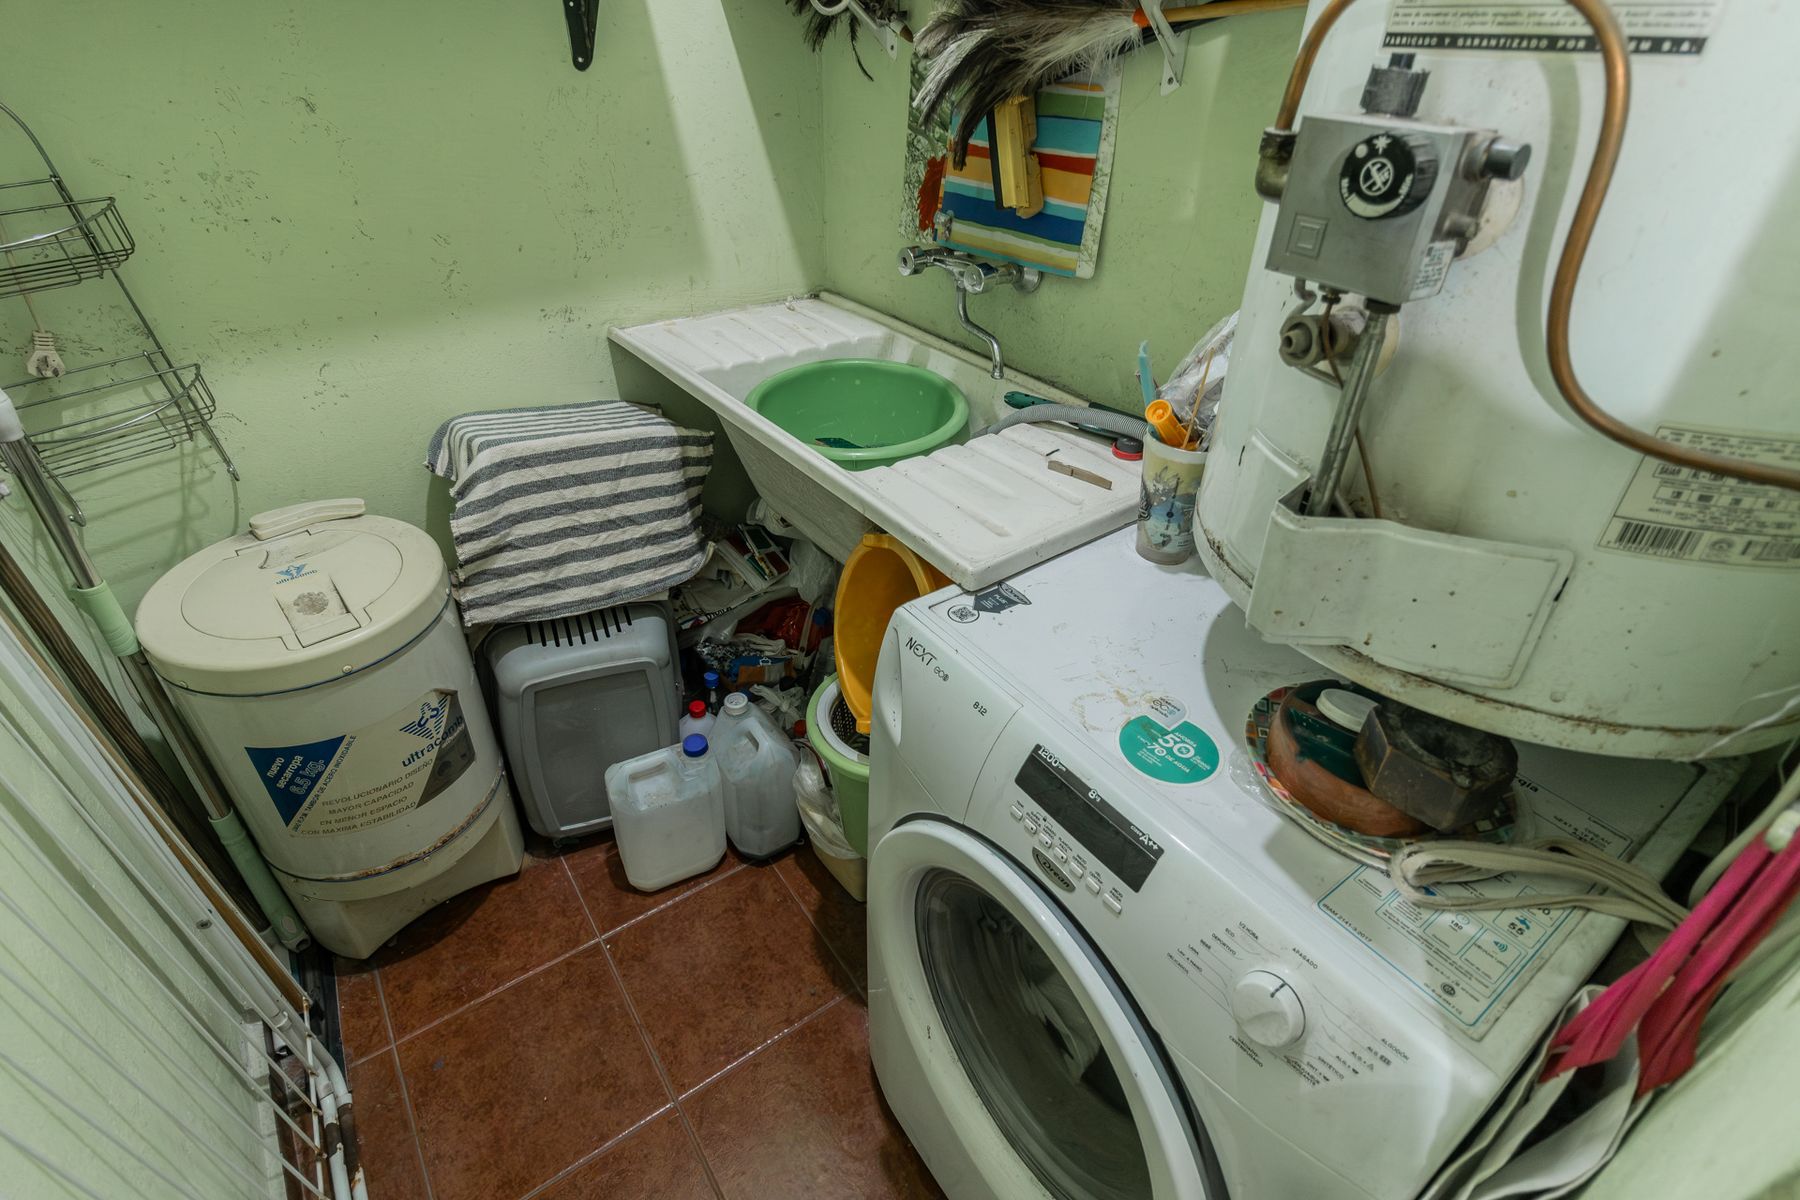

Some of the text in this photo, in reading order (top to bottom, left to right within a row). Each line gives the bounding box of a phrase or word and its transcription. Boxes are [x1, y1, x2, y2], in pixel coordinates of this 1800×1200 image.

[1384, 35, 1438, 47] FABRICADO
[1456, 36, 1549, 49] GARANTIZADO
[1556, 39, 1586, 50] POR
[905, 636, 937, 666] NEXT
[401, 715, 464, 767] ultracomb
[266, 756, 285, 779] nuevo
[275, 754, 305, 790] secarropa
[321, 757, 434, 807] REVOLUCIONARIO DISEÑO
[319, 818, 333, 827] EN
[333, 811, 368, 826] MENOR
[369, 795, 408, 817] ESPACIO
[328, 781, 415, 816] MAYOR CAPACIDAD
[300, 828, 320, 836] CON
[321, 822, 359, 836] MAXIMA
[360, 800, 417, 829] ESTABILIDAD
[1211, 932, 1237, 956] DEPORTIVO
[1291, 946, 1319, 970] APAGADO
